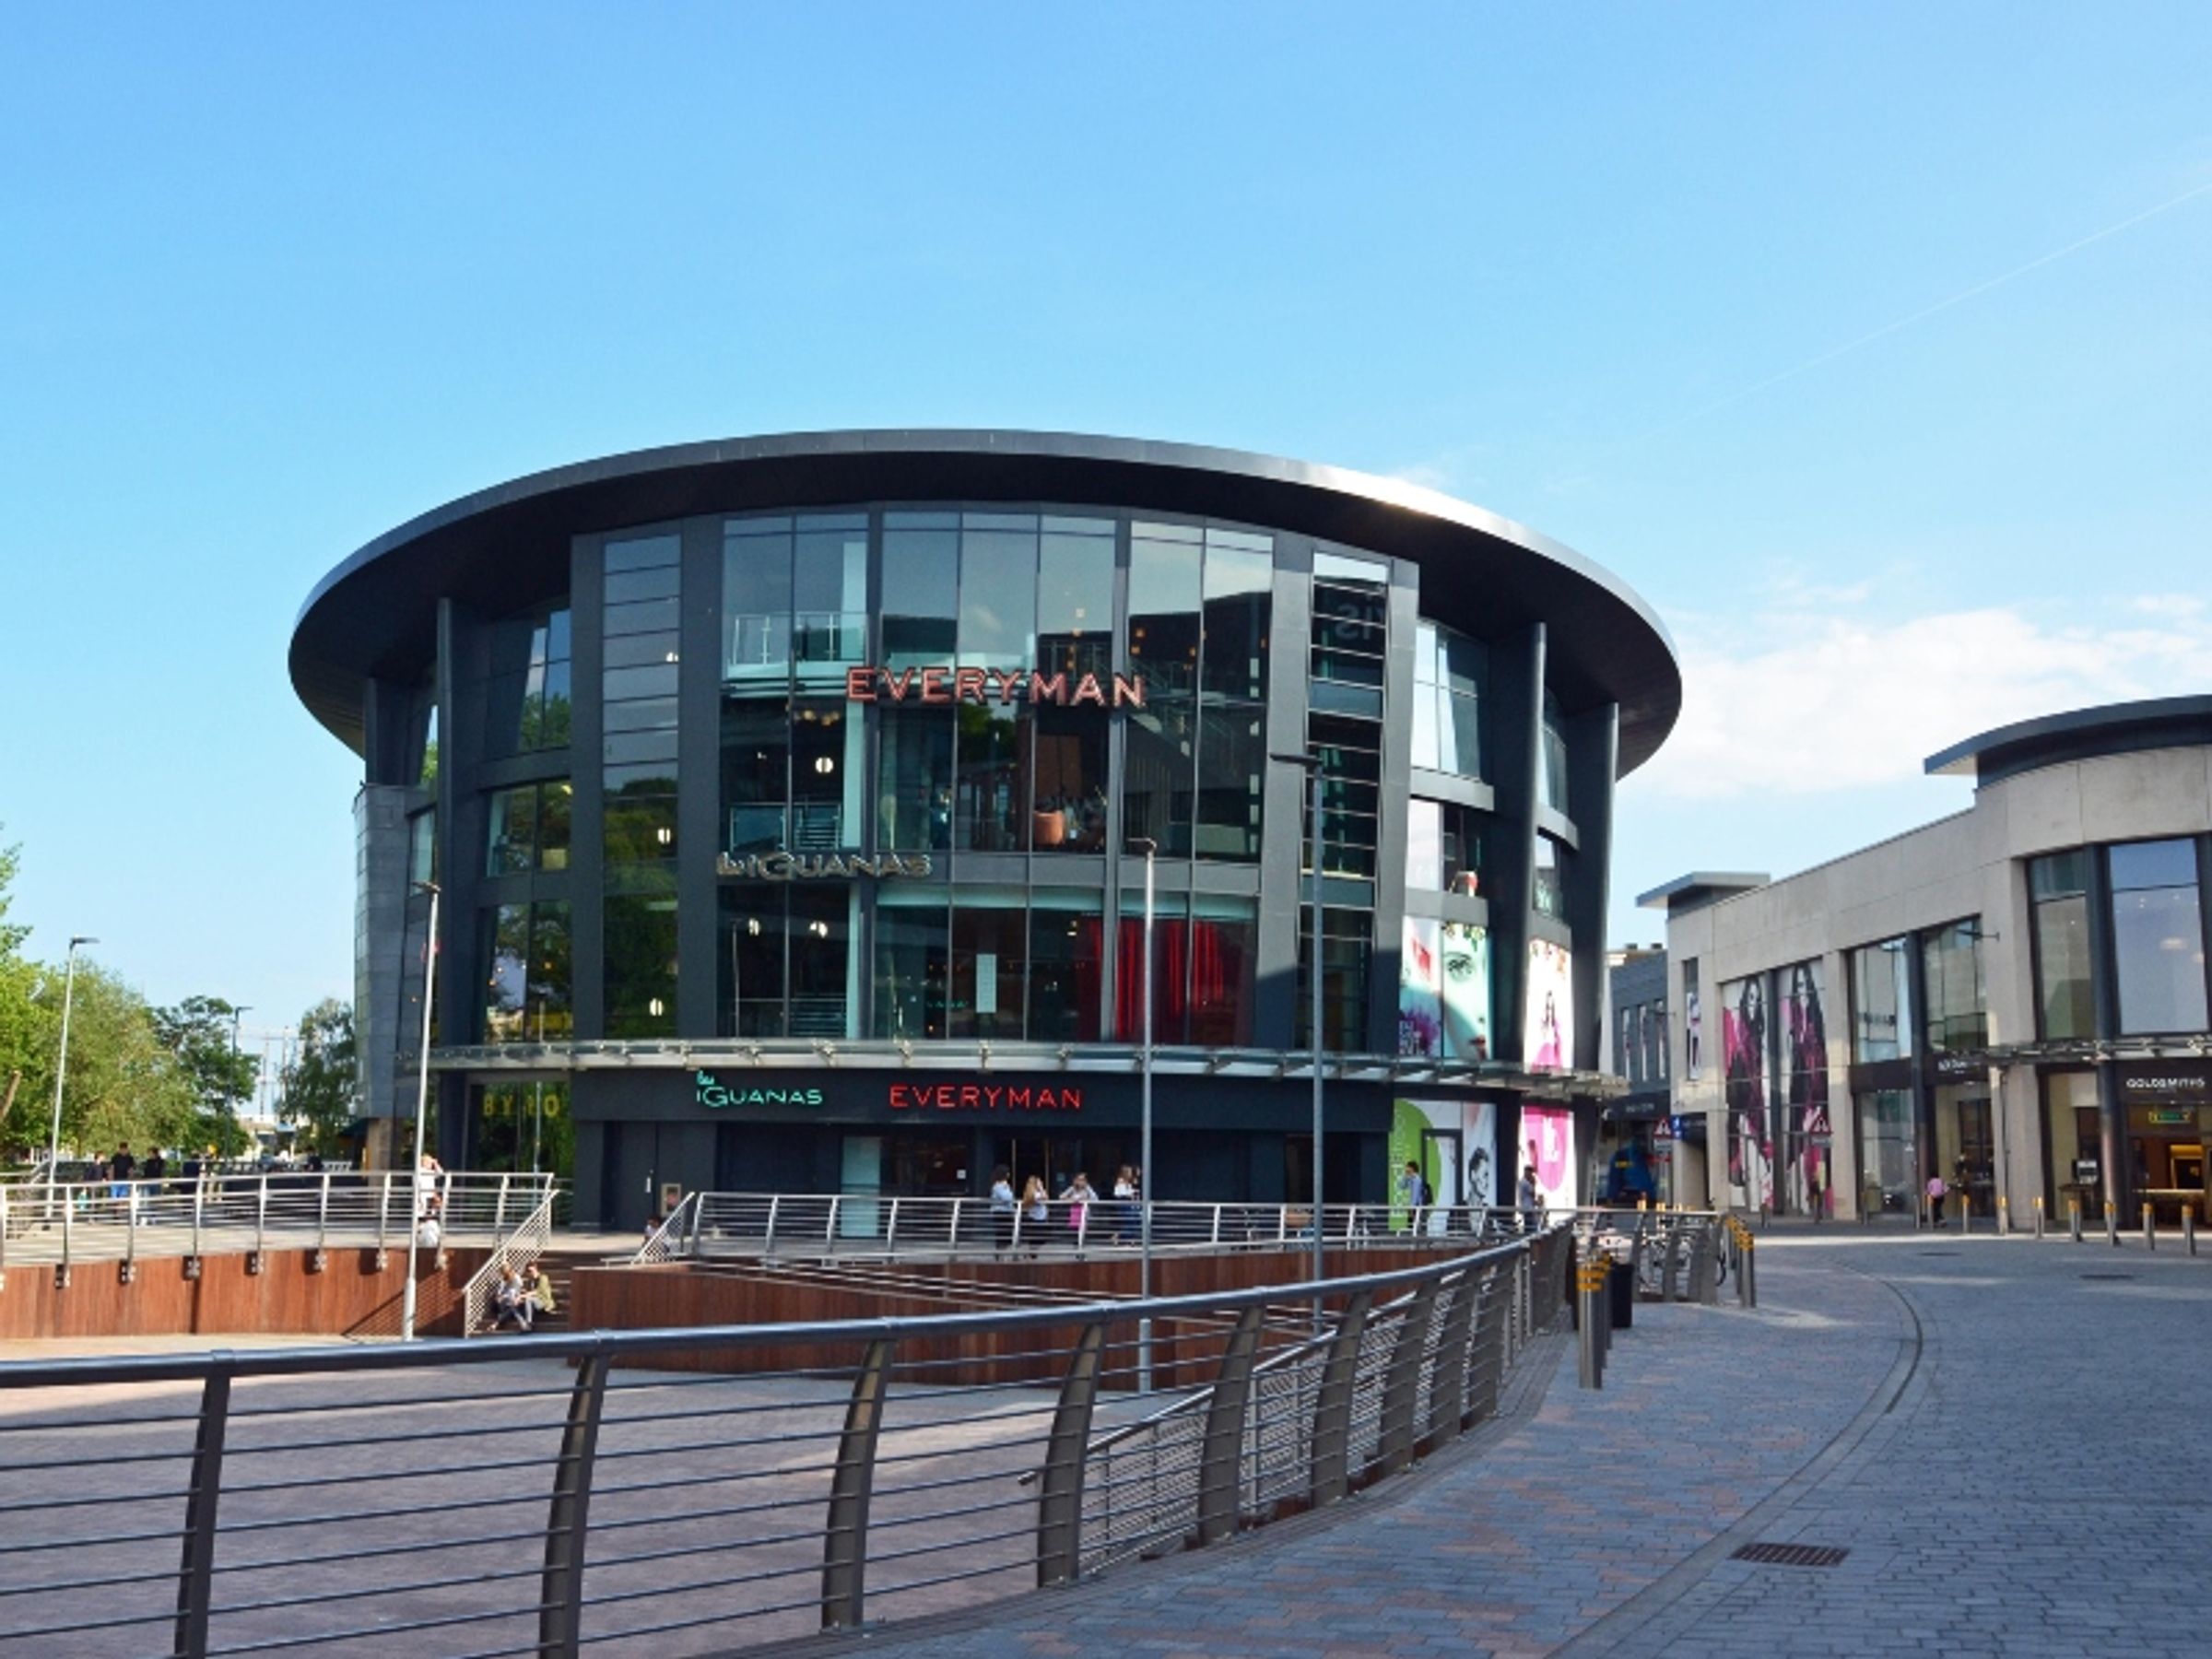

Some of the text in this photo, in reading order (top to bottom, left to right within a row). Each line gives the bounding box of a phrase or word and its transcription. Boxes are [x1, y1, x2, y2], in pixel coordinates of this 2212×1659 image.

[846, 665, 1147, 707] EVERYMAN
[696, 1086, 823, 1107] IGUANAS
[888, 1085, 1084, 1109] EVERYMAN
